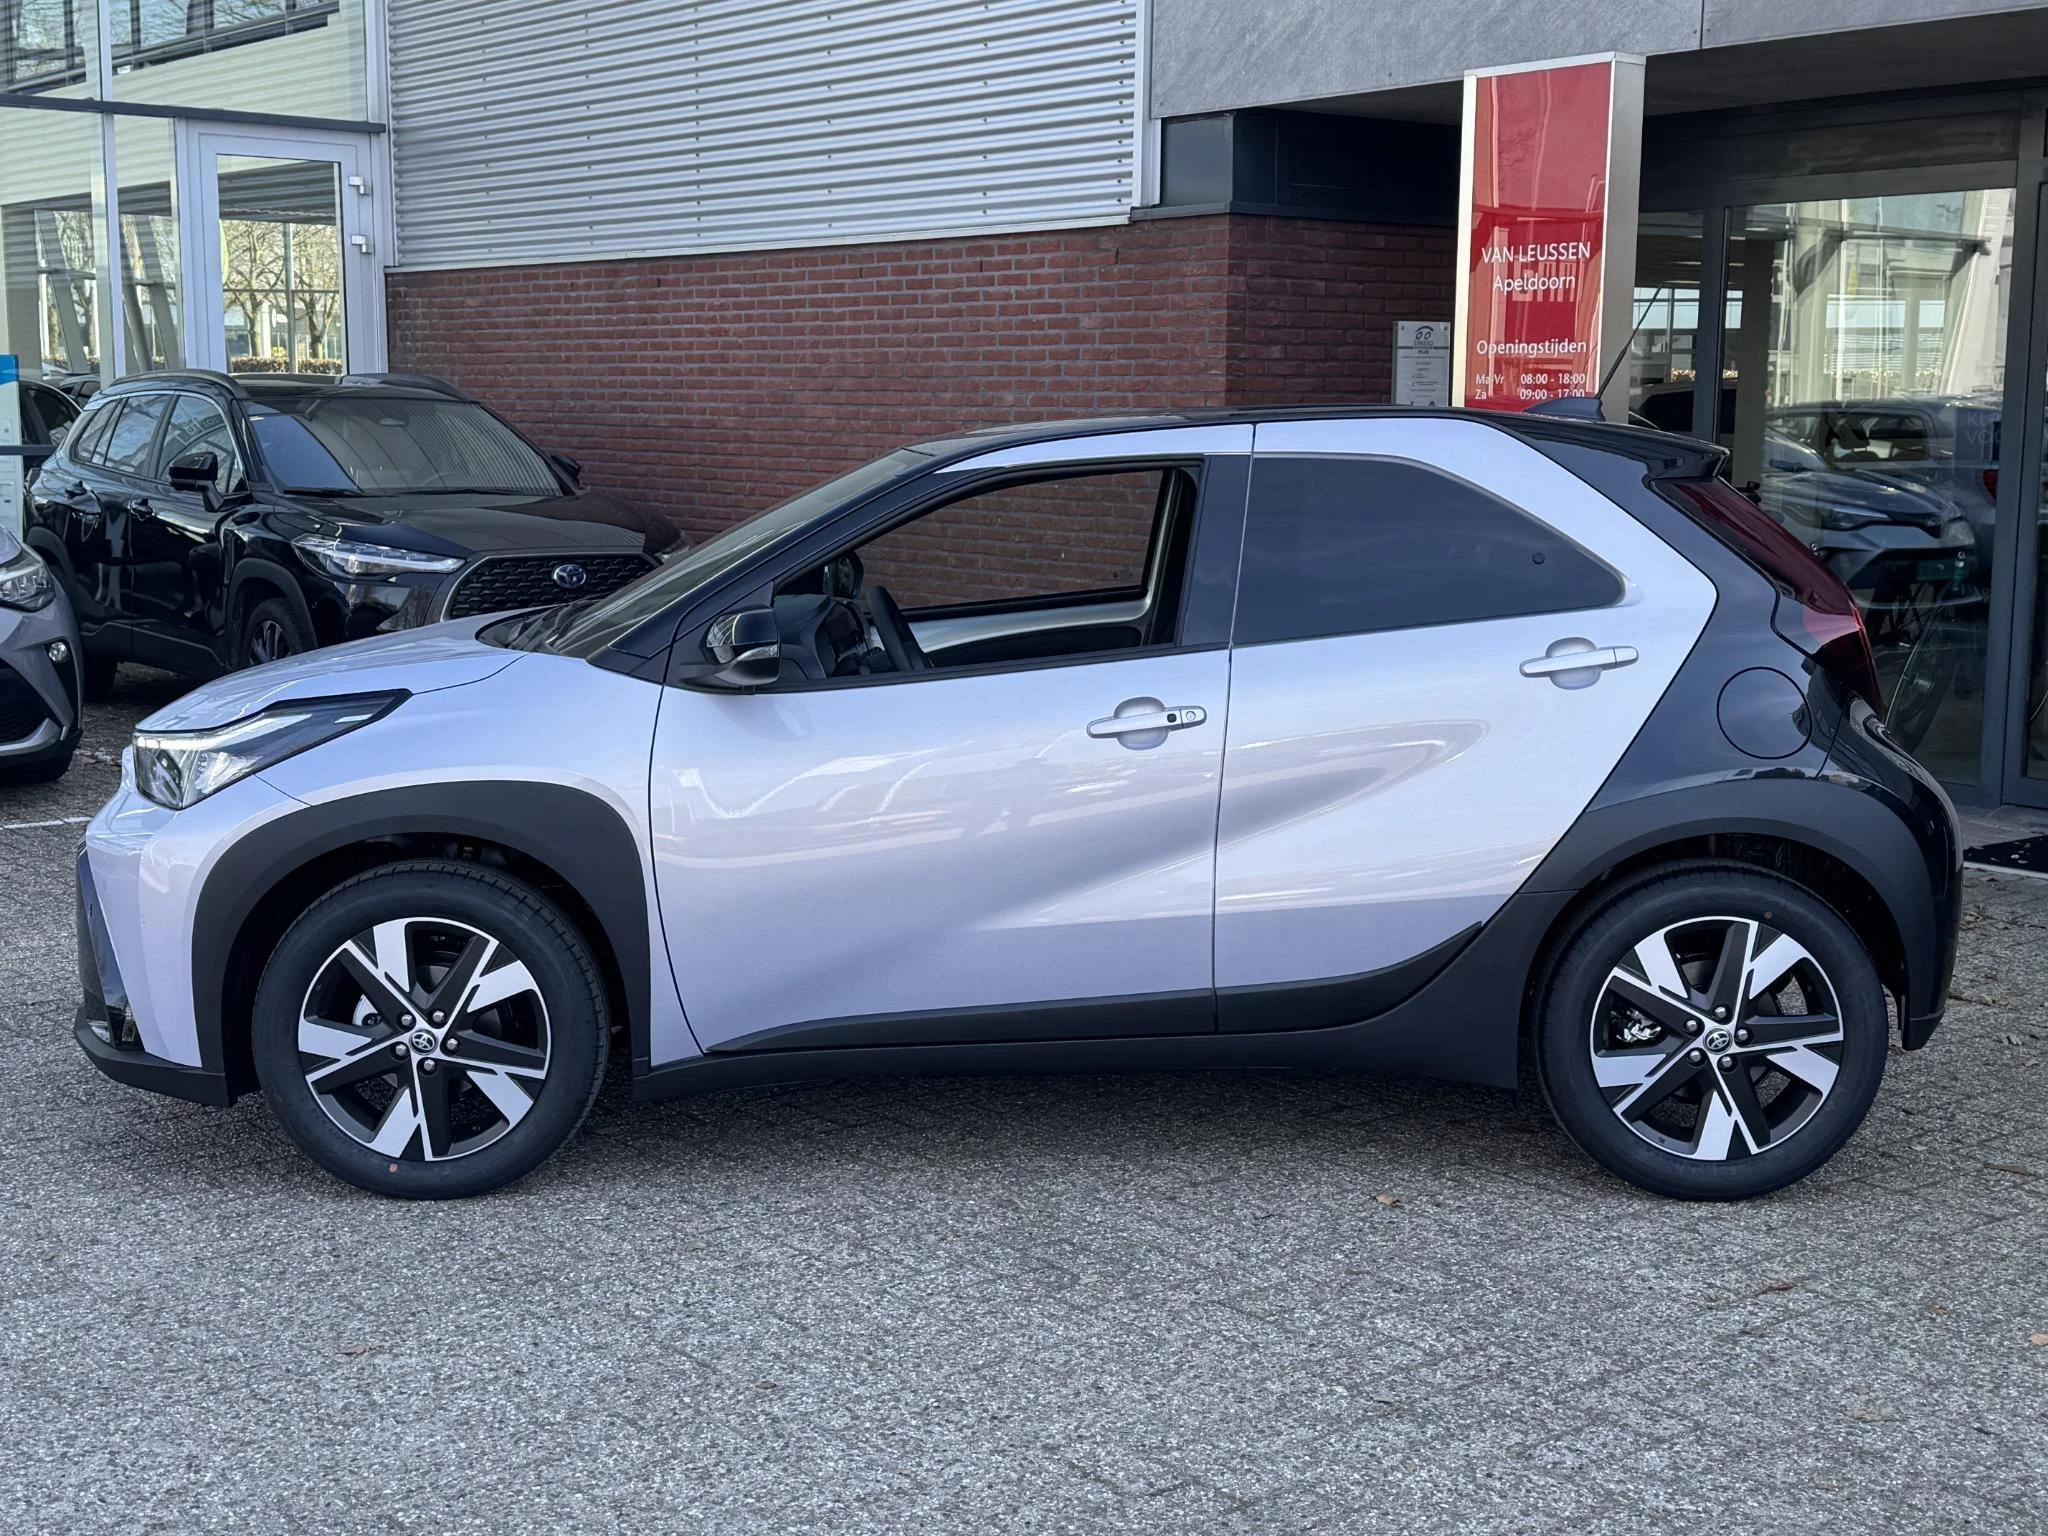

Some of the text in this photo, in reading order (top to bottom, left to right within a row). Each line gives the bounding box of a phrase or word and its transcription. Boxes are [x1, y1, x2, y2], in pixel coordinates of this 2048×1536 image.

[1481, 241, 1591, 264] VAN LEUSSEN
[1493, 272, 1575, 296] Apeldoorn
[1476, 338, 1587, 359] Openingstijden
[1520, 373, 1548, 385] 08:00
[1558, 373, 1586, 384] 18:00
[1475, 389, 1487, 400] Za
[1520, 389, 1547, 400] 09:00
